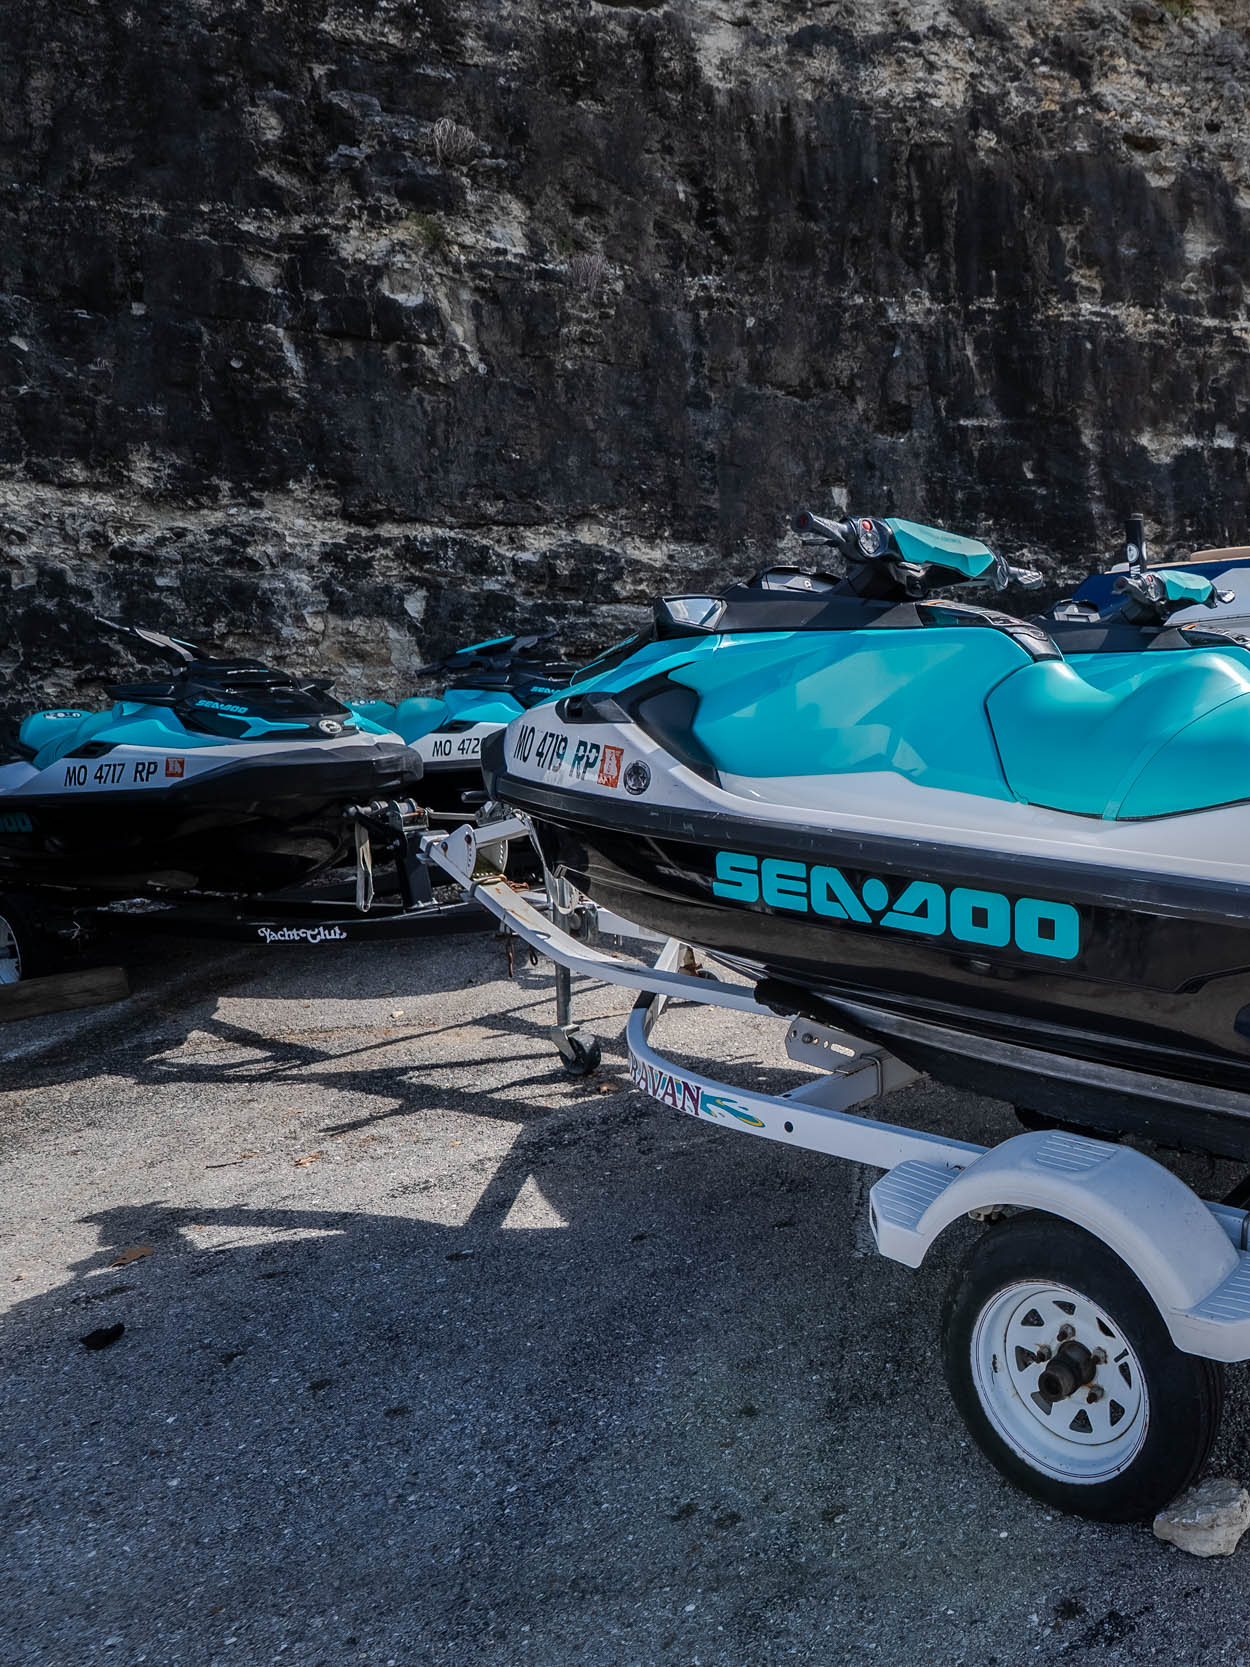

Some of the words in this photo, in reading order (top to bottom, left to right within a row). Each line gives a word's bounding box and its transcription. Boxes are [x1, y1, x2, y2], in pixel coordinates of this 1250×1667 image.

[432, 740, 452, 757] MO
[457, 737, 481, 755] 472
[513, 724, 536, 763] MO
[569, 740, 601, 781] RP
[64, 764, 88, 786] MO
[93, 762, 126, 784] 4717
[133, 761, 158, 782] RP
